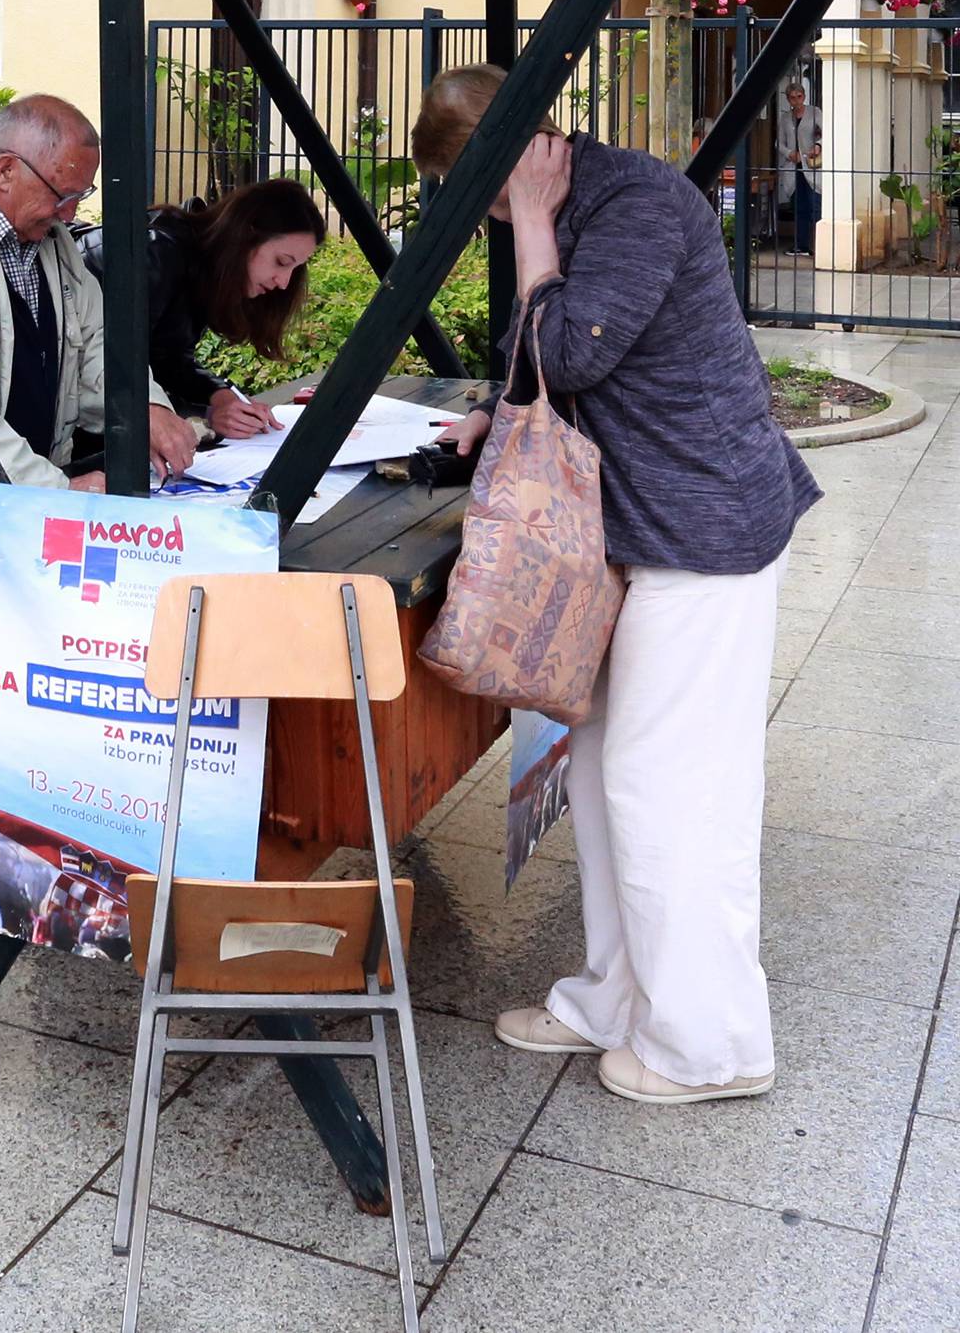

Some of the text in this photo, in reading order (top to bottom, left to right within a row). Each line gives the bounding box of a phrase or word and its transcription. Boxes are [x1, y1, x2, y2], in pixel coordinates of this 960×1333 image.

[89, 515, 184, 552] narod
[120, 549, 182, 565] ODLUČUJE
[104, 725, 237, 755] ZA PRAVDNIJI
[104, 741, 236, 775] izborni stav!
[52, 803, 147, 837] narododlucuje.hr
